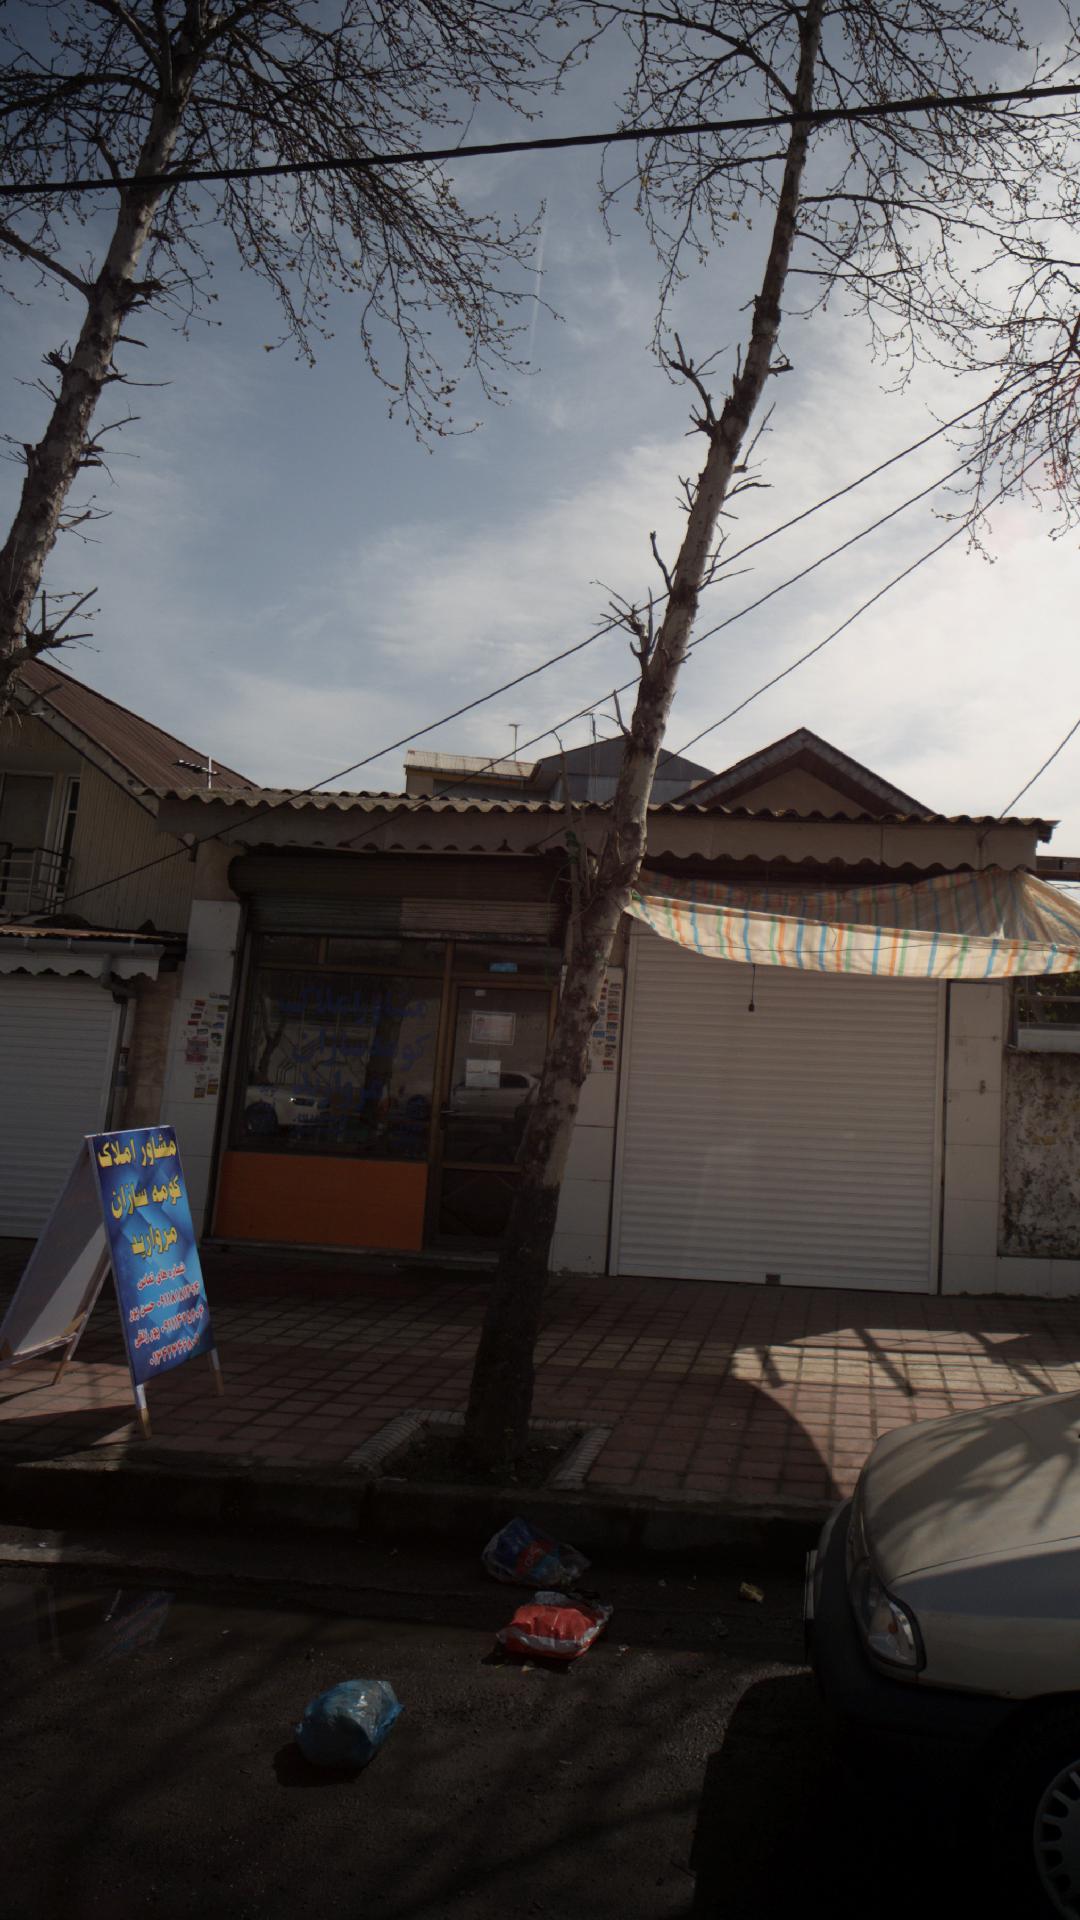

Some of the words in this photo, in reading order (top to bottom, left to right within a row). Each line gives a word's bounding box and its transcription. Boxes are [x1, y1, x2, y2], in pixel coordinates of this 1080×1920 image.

[97, 1138, 136, 1168] املاک
[141, 1134, 177, 1167] مشاور
[111, 1184, 149, 1220] سازان
[131, 1224, 178, 1259] مروارید
[137, 1272, 154, 1290] تماس
[156, 1269, 168, 1285] های
[169, 1262, 185, 1280] شماره
